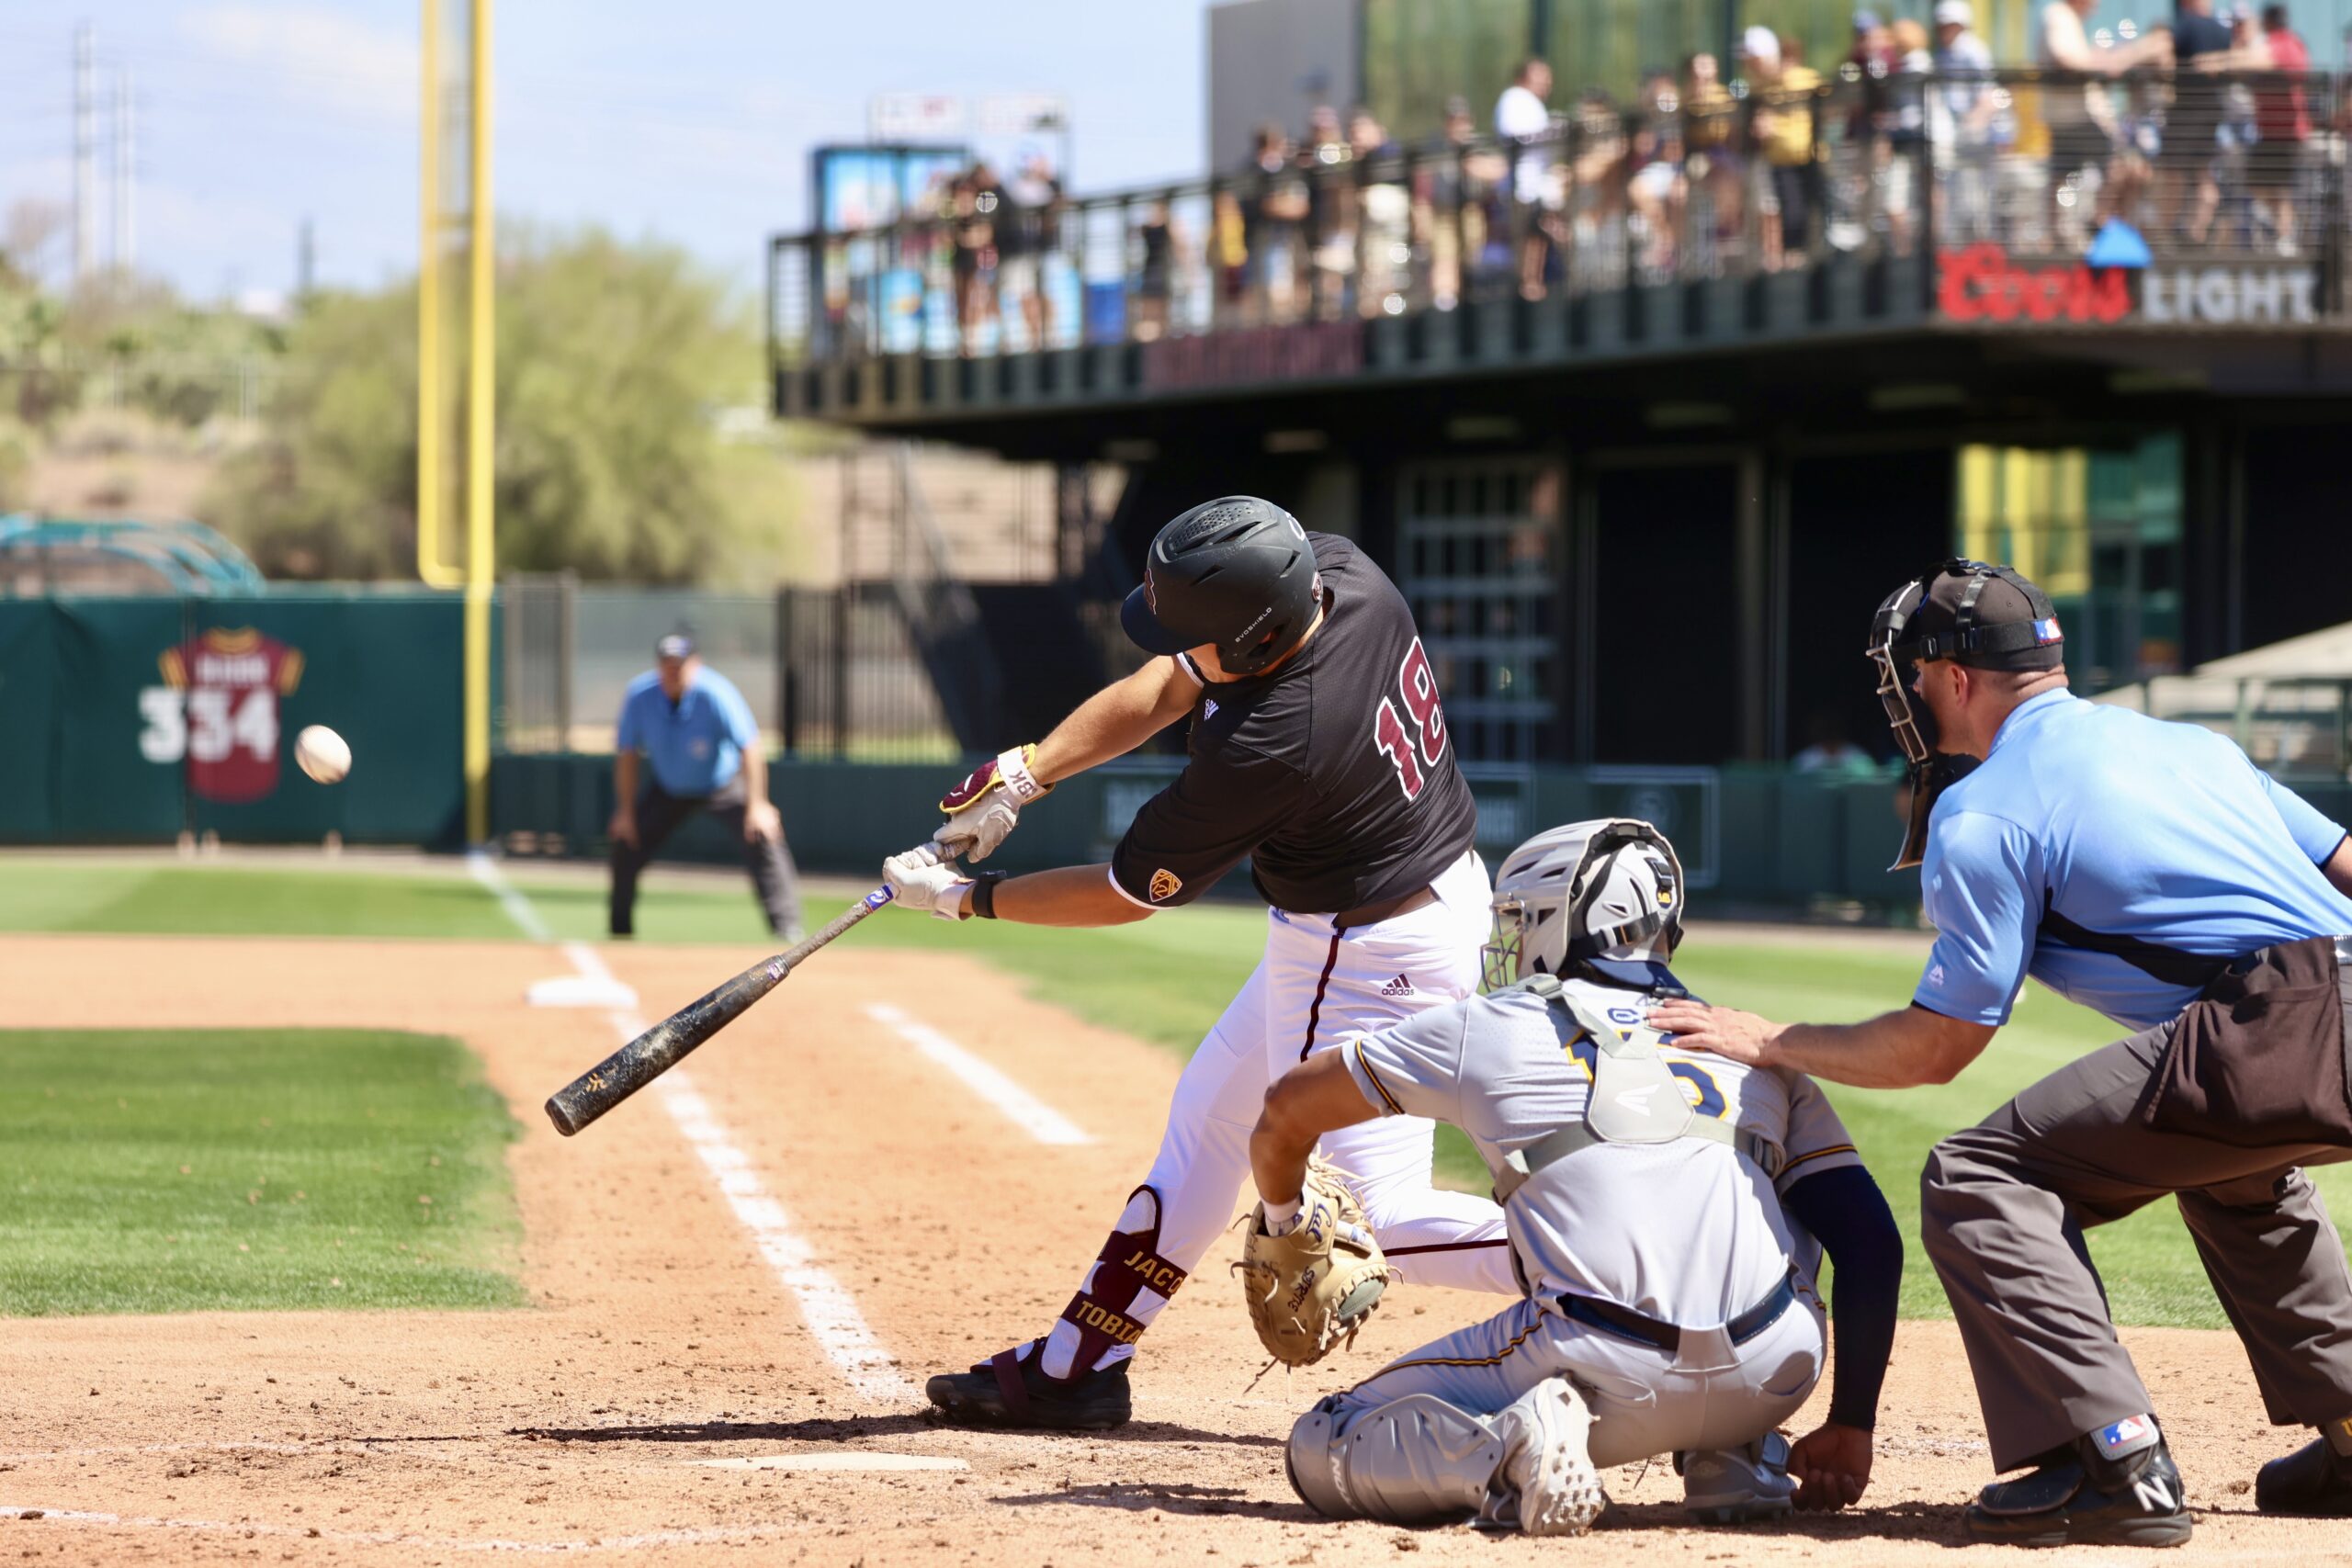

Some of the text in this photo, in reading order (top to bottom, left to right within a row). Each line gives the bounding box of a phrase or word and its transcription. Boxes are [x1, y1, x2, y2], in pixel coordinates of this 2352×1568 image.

[2142, 268, 2316, 323] LIGHT
[140, 686, 280, 763] 334
[1374, 636, 1446, 801] 18
[1152, 884, 1169, 897] 12
[1381, 987, 1415, 997] adidas
[2134, 1475, 2177, 1512] N
